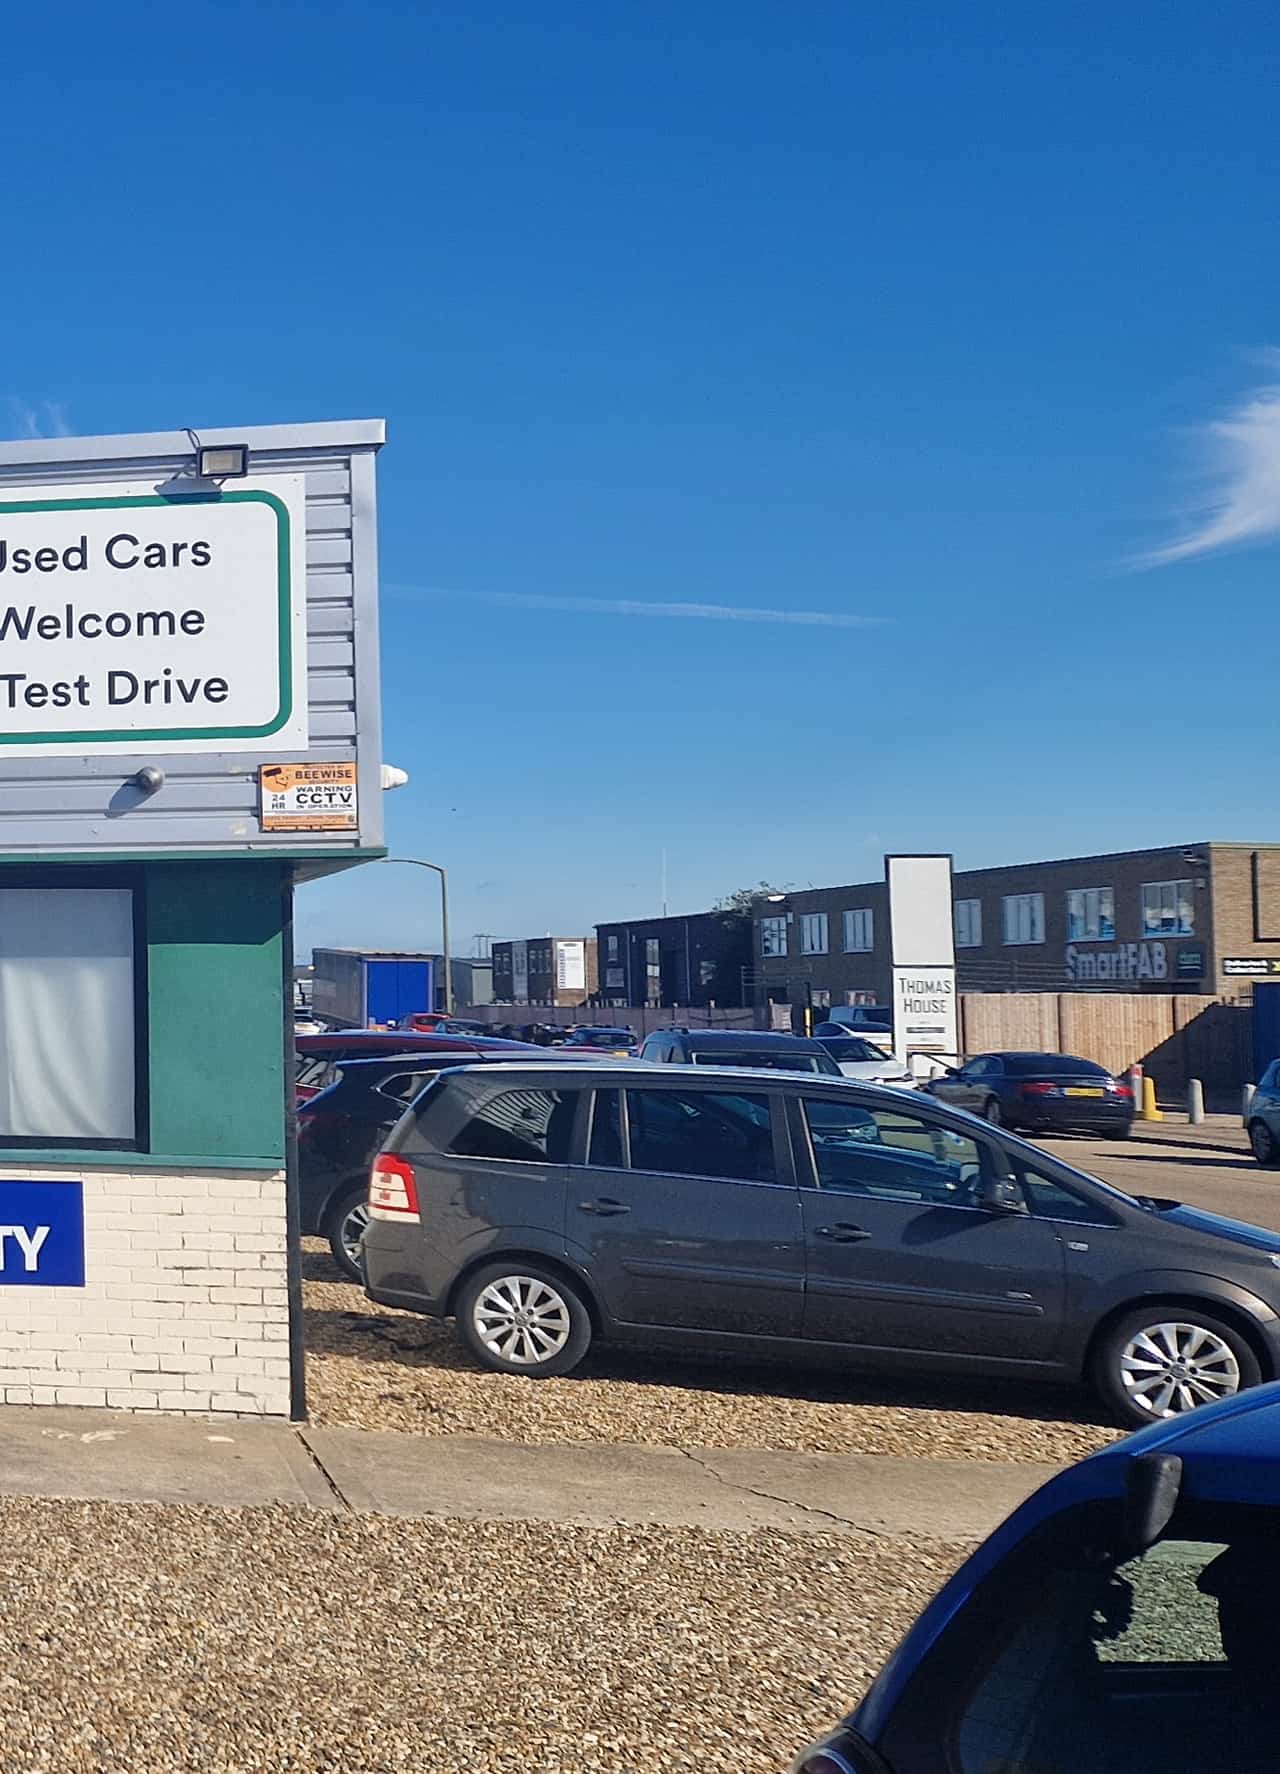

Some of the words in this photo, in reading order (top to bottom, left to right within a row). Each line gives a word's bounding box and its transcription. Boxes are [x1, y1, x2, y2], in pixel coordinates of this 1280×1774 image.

[104, 533, 212, 569] Cars
[107, 668, 229, 706] Drive
[295, 769, 352, 779] BEEWISE
[296, 793, 353, 804] CCTV
[1065, 942, 1168, 980] SmartFAB
[899, 977, 952, 994] THOMAS
[904, 998, 947, 1013] HOUSE
